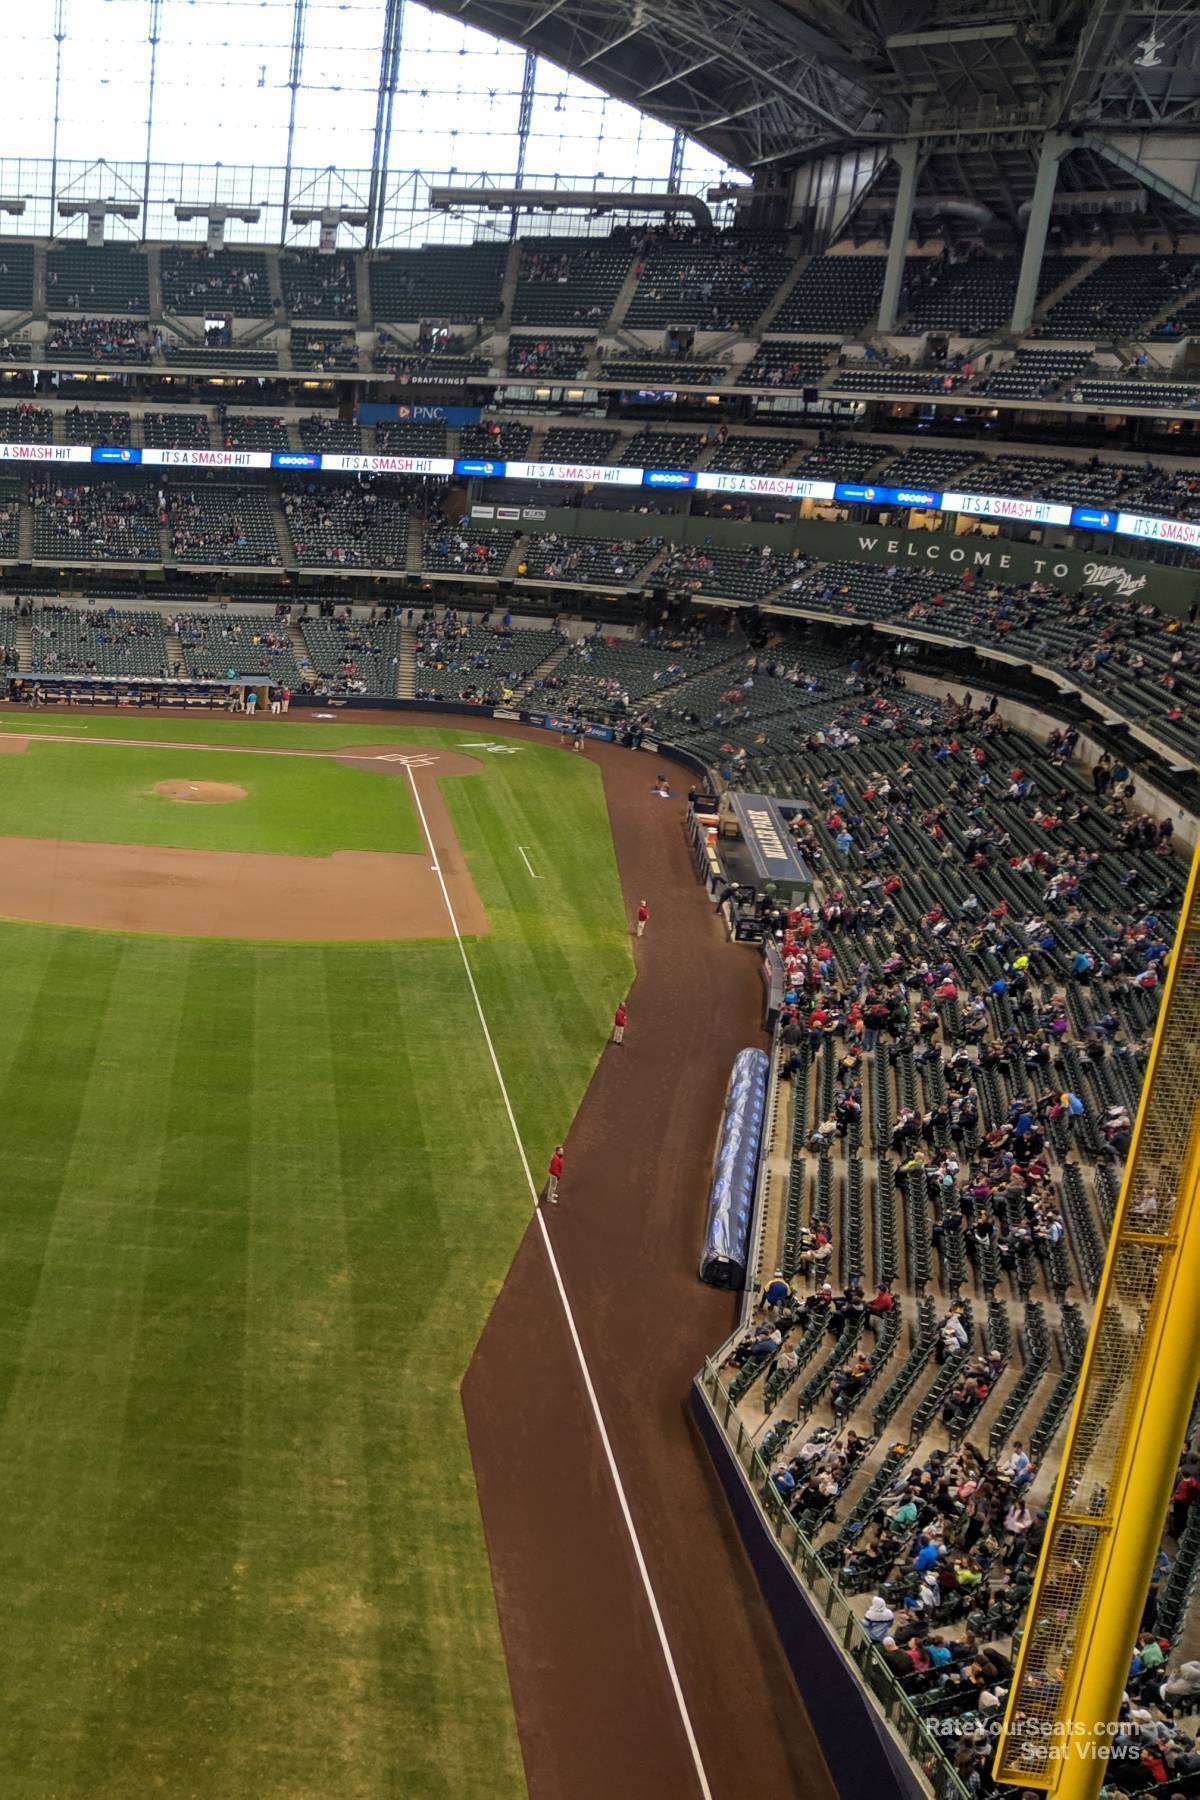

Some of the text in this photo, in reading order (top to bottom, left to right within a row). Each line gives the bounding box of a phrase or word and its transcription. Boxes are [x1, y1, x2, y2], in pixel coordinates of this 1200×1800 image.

[411, 376, 465, 385] DRAFTKINGS
[413, 406, 444, 419] PNC
[3, 446, 9, 457] A
[12, 446, 53, 458] SMASH
[55, 448, 72, 459] HIT
[182, 452, 189, 463] A
[191, 452, 232, 465] SMASH
[234, 453, 251, 465] HIT
[363, 459, 369, 469] A
[371, 458, 413, 471] SMASH
[416, 459, 433, 472] HIT
[548, 467, 555, 478] A
[558, 466, 600, 480] SMASH
[603, 468, 621, 481] HIT
[739, 478, 746, 490] A
[748, 478, 794, 493] SMASH
[796, 482, 814, 494] HIT
[983, 500, 990, 512] A
[993, 499, 1033, 517] SMASH
[1034, 504, 1051, 519] HIT
[1151, 522, 1158, 536] A
[1159, 522, 1195, 540] SMASH
[858, 537, 1011, 569] WELCOME
[1033, 560, 1069, 578] TO
[1112, 571, 1147, 597] Park
[747, 809, 789, 860] MILLER PARK
